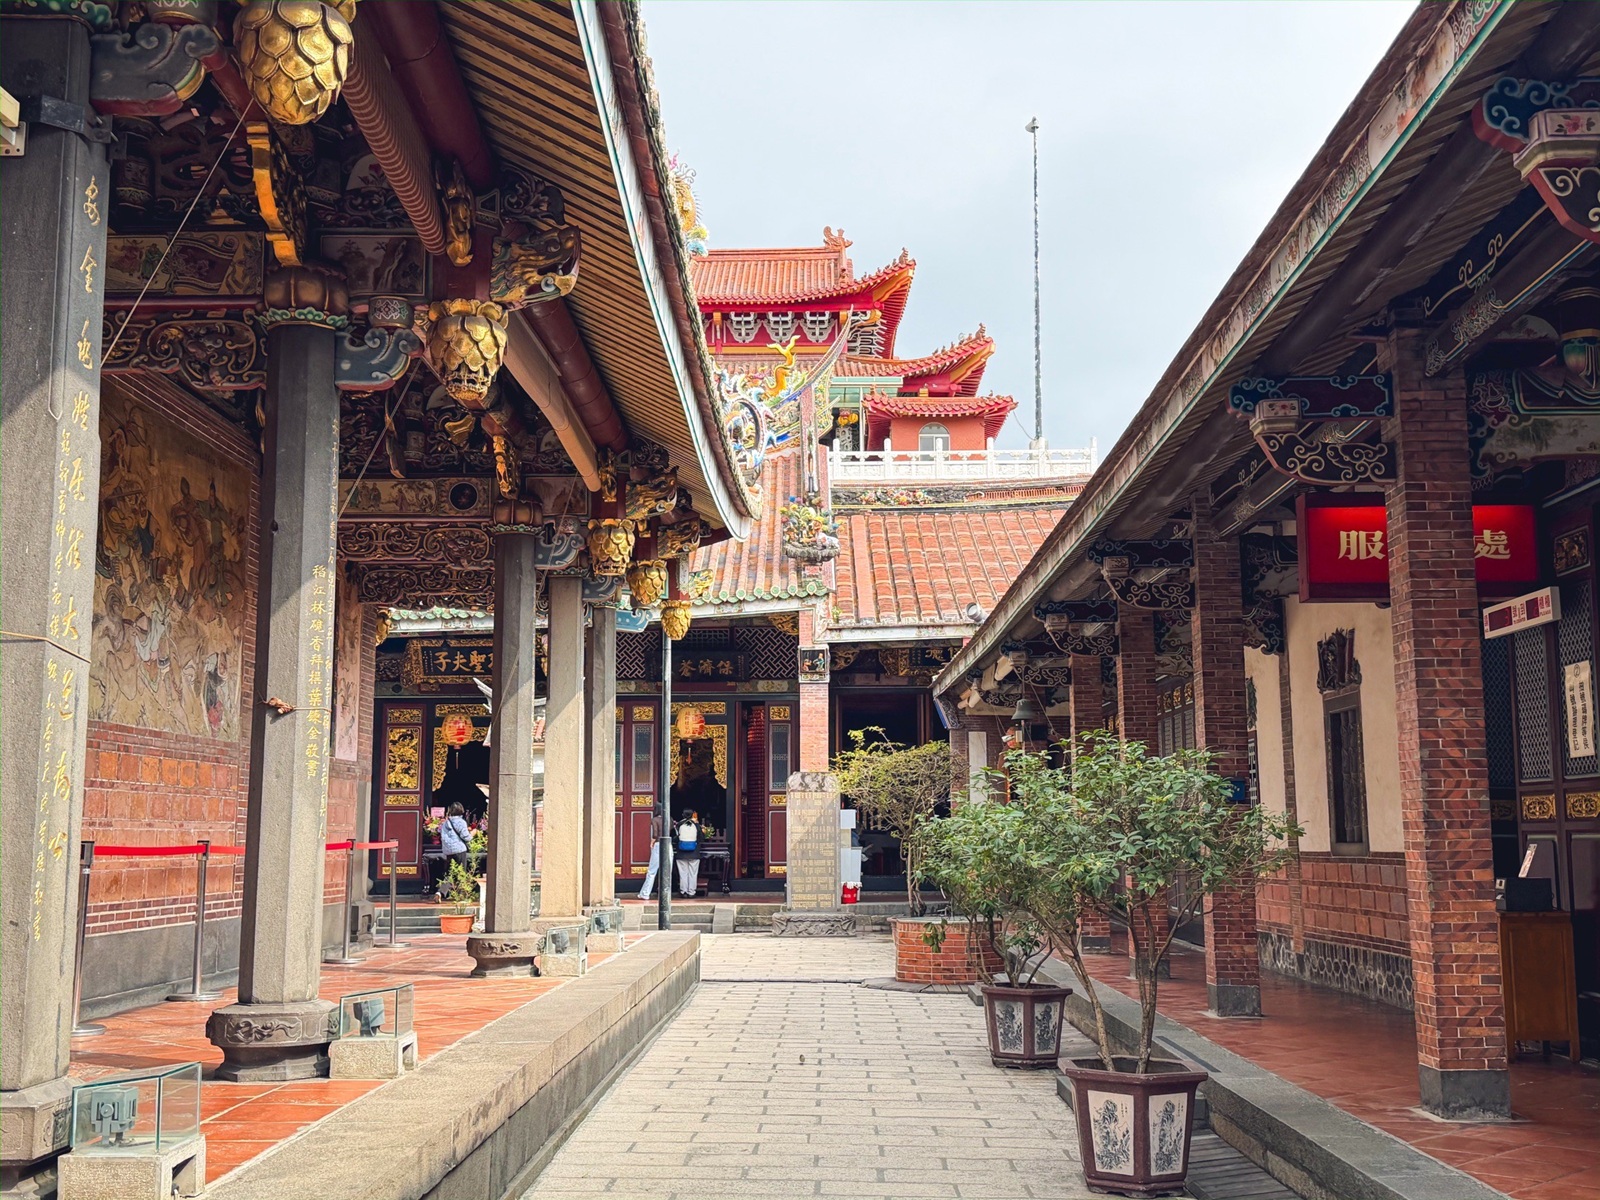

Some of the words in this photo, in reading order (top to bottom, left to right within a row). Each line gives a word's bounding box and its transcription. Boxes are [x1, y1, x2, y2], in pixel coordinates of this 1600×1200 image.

[1338, 529, 1511, 560] 服處
[661, 659, 734, 677] 保濟蒼
